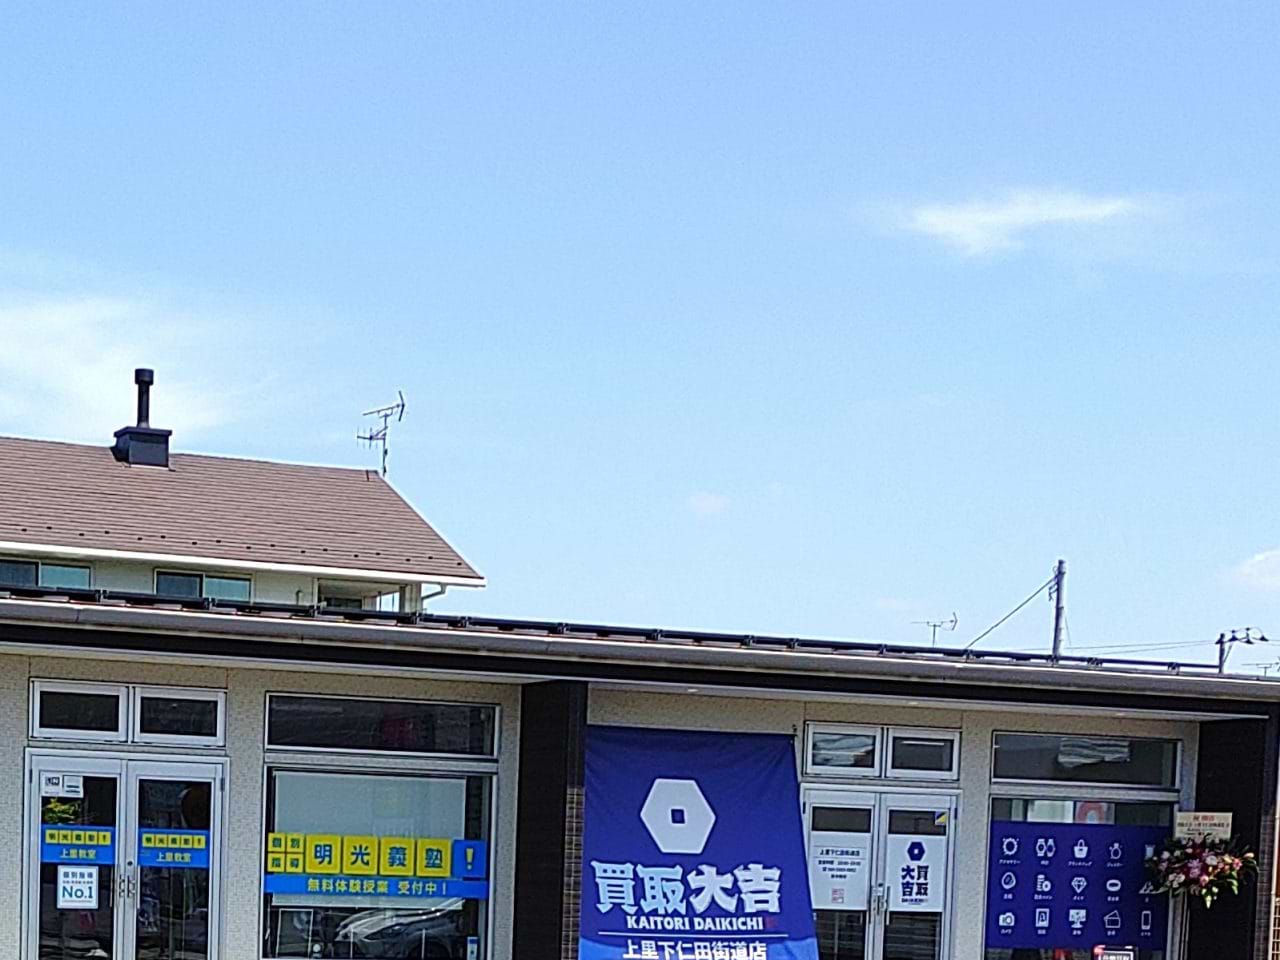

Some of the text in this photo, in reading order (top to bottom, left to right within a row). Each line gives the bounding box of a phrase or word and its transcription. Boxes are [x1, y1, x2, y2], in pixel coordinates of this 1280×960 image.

[62, 885, 94, 899] No.1
[307, 878, 389, 894] 無料体験授業
[590, 860, 782, 915] 買取大吉
[626, 915, 763, 931] KAITORI DAIKICHI
[622, 939, 767, 960] 上里下仁田街道店
